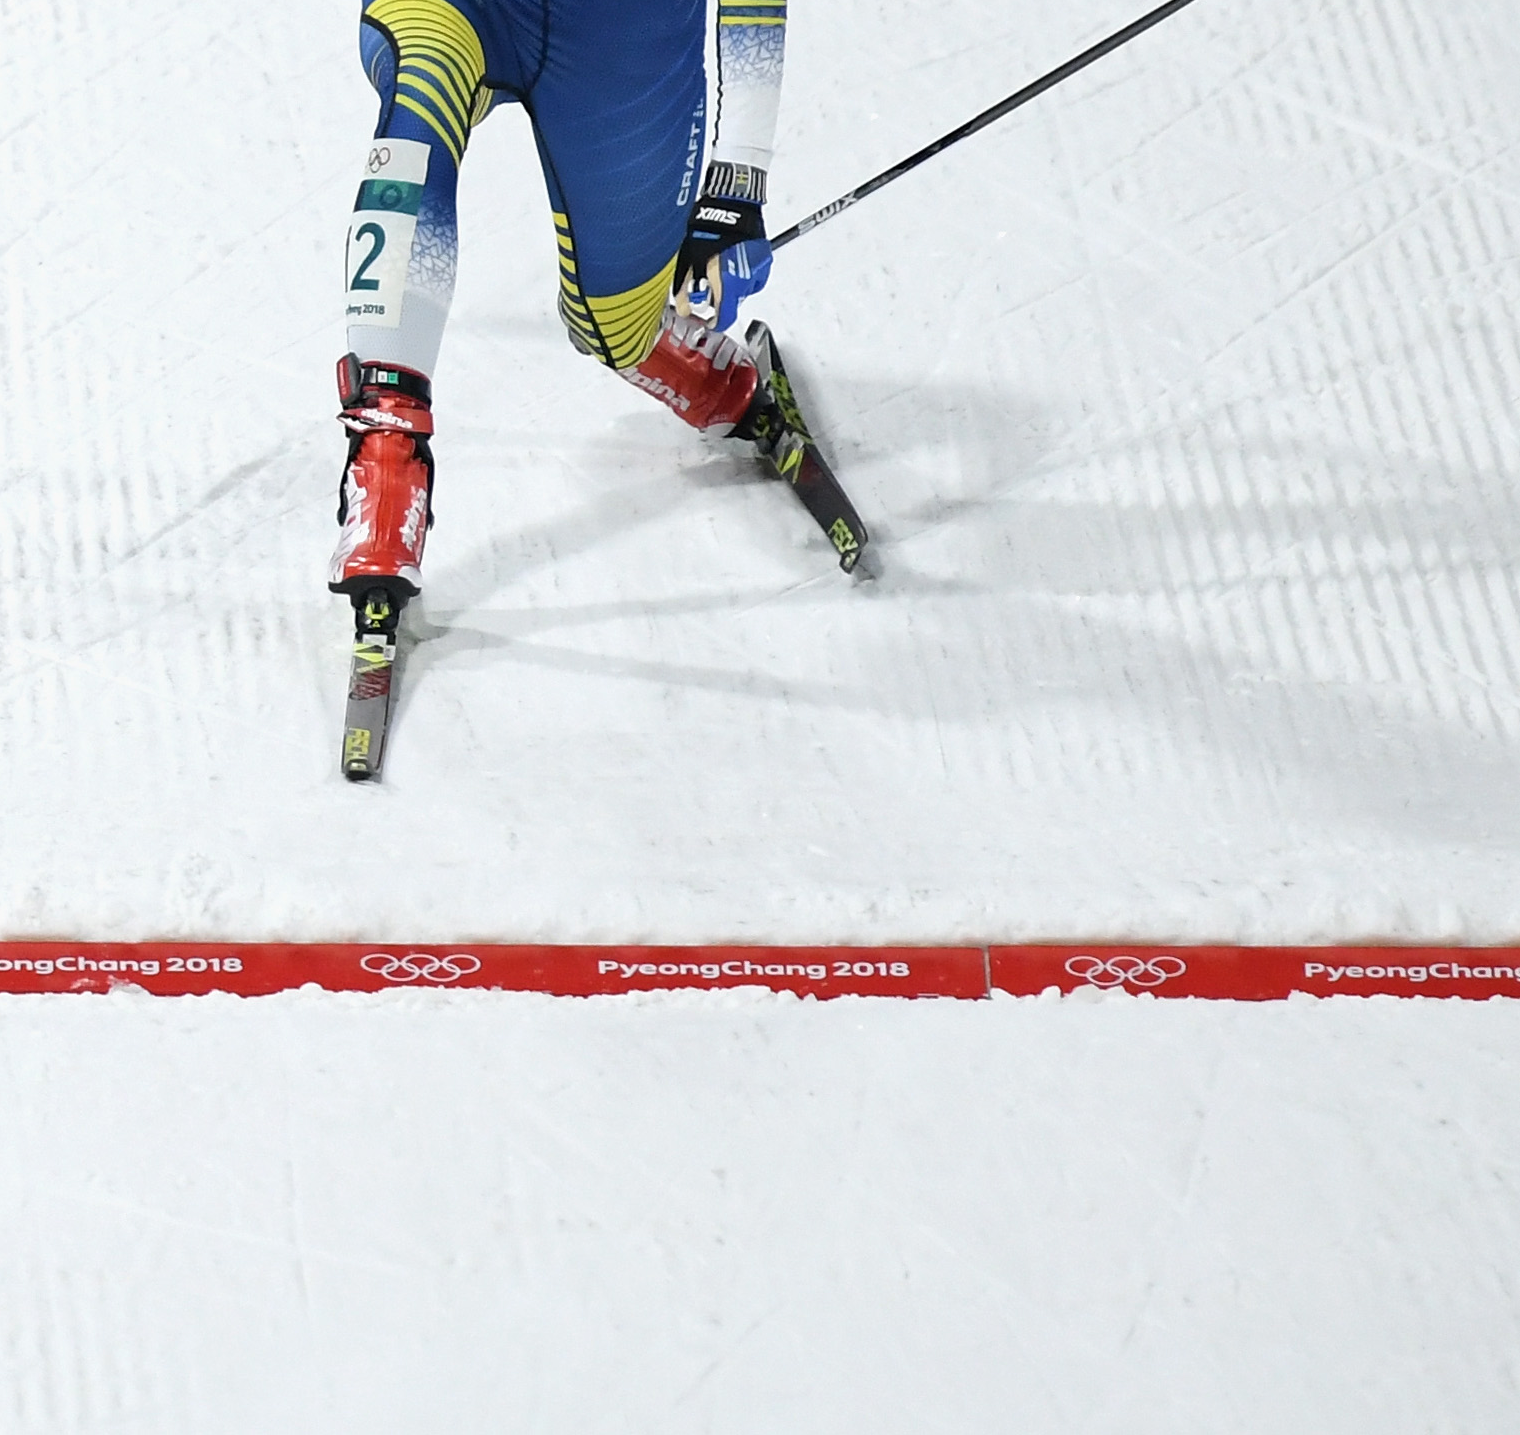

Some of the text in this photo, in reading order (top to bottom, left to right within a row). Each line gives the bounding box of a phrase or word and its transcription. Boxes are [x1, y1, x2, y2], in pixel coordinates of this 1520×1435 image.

[676, 122, 701, 207] CRAFT
[797, 190, 858, 236] SWIX
[345, 221, 386, 292] 2
[165, 957, 244, 973] 2018
[598, 960, 910, 980] PyeongChang 2018
